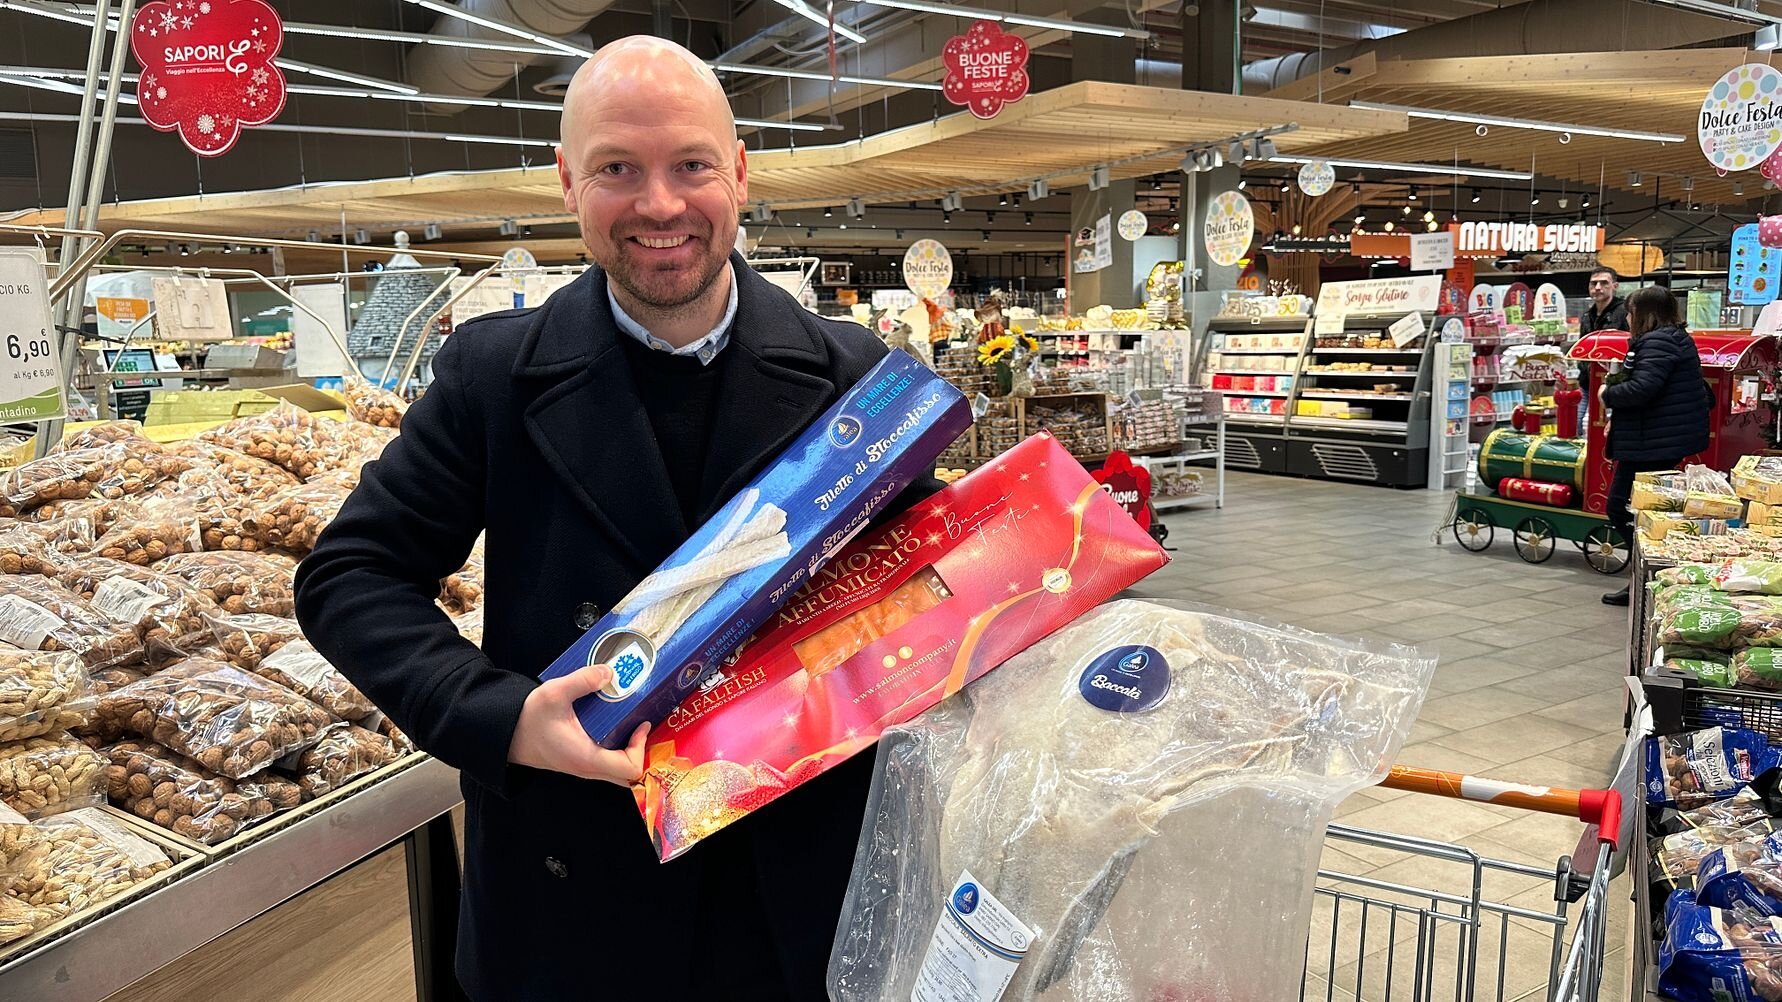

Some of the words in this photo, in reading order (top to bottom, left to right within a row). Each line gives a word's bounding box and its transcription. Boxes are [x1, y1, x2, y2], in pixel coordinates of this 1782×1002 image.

[164, 45, 225, 63] SAPORI
[959, 51, 1012, 66] BUONE
[166, 67, 186, 75] Viaggio
[964, 65, 1008, 79] FESTE
[1702, 110, 1740, 130] Dolce
[1747, 100, 1782, 123] Festa
[1713, 127, 1730, 138] PARTY
[1737, 123, 1751, 133] CAKE
[1753, 120, 1775, 131] DESIGN
[1206, 222, 1226, 236] Dolce
[1229, 217, 1249, 232] Festa
[1459, 221, 1538, 252] NATURA
[1543, 224, 1598, 253] SUSHI
[906, 262, 927, 273] Dolce
[930, 260, 949, 273] Festa
[17, 284, 33, 295] KG.
[1344, 289, 1373, 307] Senza
[1375, 287, 1409, 305] Glutine
[41, 328, 47, 337] €
[7, 334, 50, 363] 6,90
[13, 371, 21, 379] al
[22, 370, 31, 380] Kg
[33, 369, 38, 377] €
[40, 368, 54, 378] 6,90
[855, 397, 868, 410] UN
[866, 380, 889, 400] MARE
[889, 371, 899, 382] DI
[866, 377, 912, 418] ECCELLENZE
[0, 405, 37, 418] ntadino
[814, 471, 855, 511] Filetto
[855, 460, 868, 475] di
[866, 393, 941, 463] Stoccafisso
[943, 491, 1014, 540] Buone
[769, 567, 805, 603] Filetto
[808, 552, 819, 566] di
[822, 482, 895, 554] Stoccafisso
[778, 523, 912, 608] ALMONE
[778, 537, 921, 628] AFFUMICATO
[705, 646, 716, 658] UN
[717, 629, 735, 648] MARE
[735, 617, 746, 631] DI
[709, 624, 750, 663] ECCELLENZE
[851, 637, 957, 705] www.salmoncompany.it
[1090, 674, 1142, 700] Baccalà
[695, 712, 705, 722] DEL
[705, 702, 724, 717] MONDO
[727, 689, 745, 702] SAPORE
[1703, 741, 1724, 786] Selezioni
[975, 945, 990, 960] EXTRA
